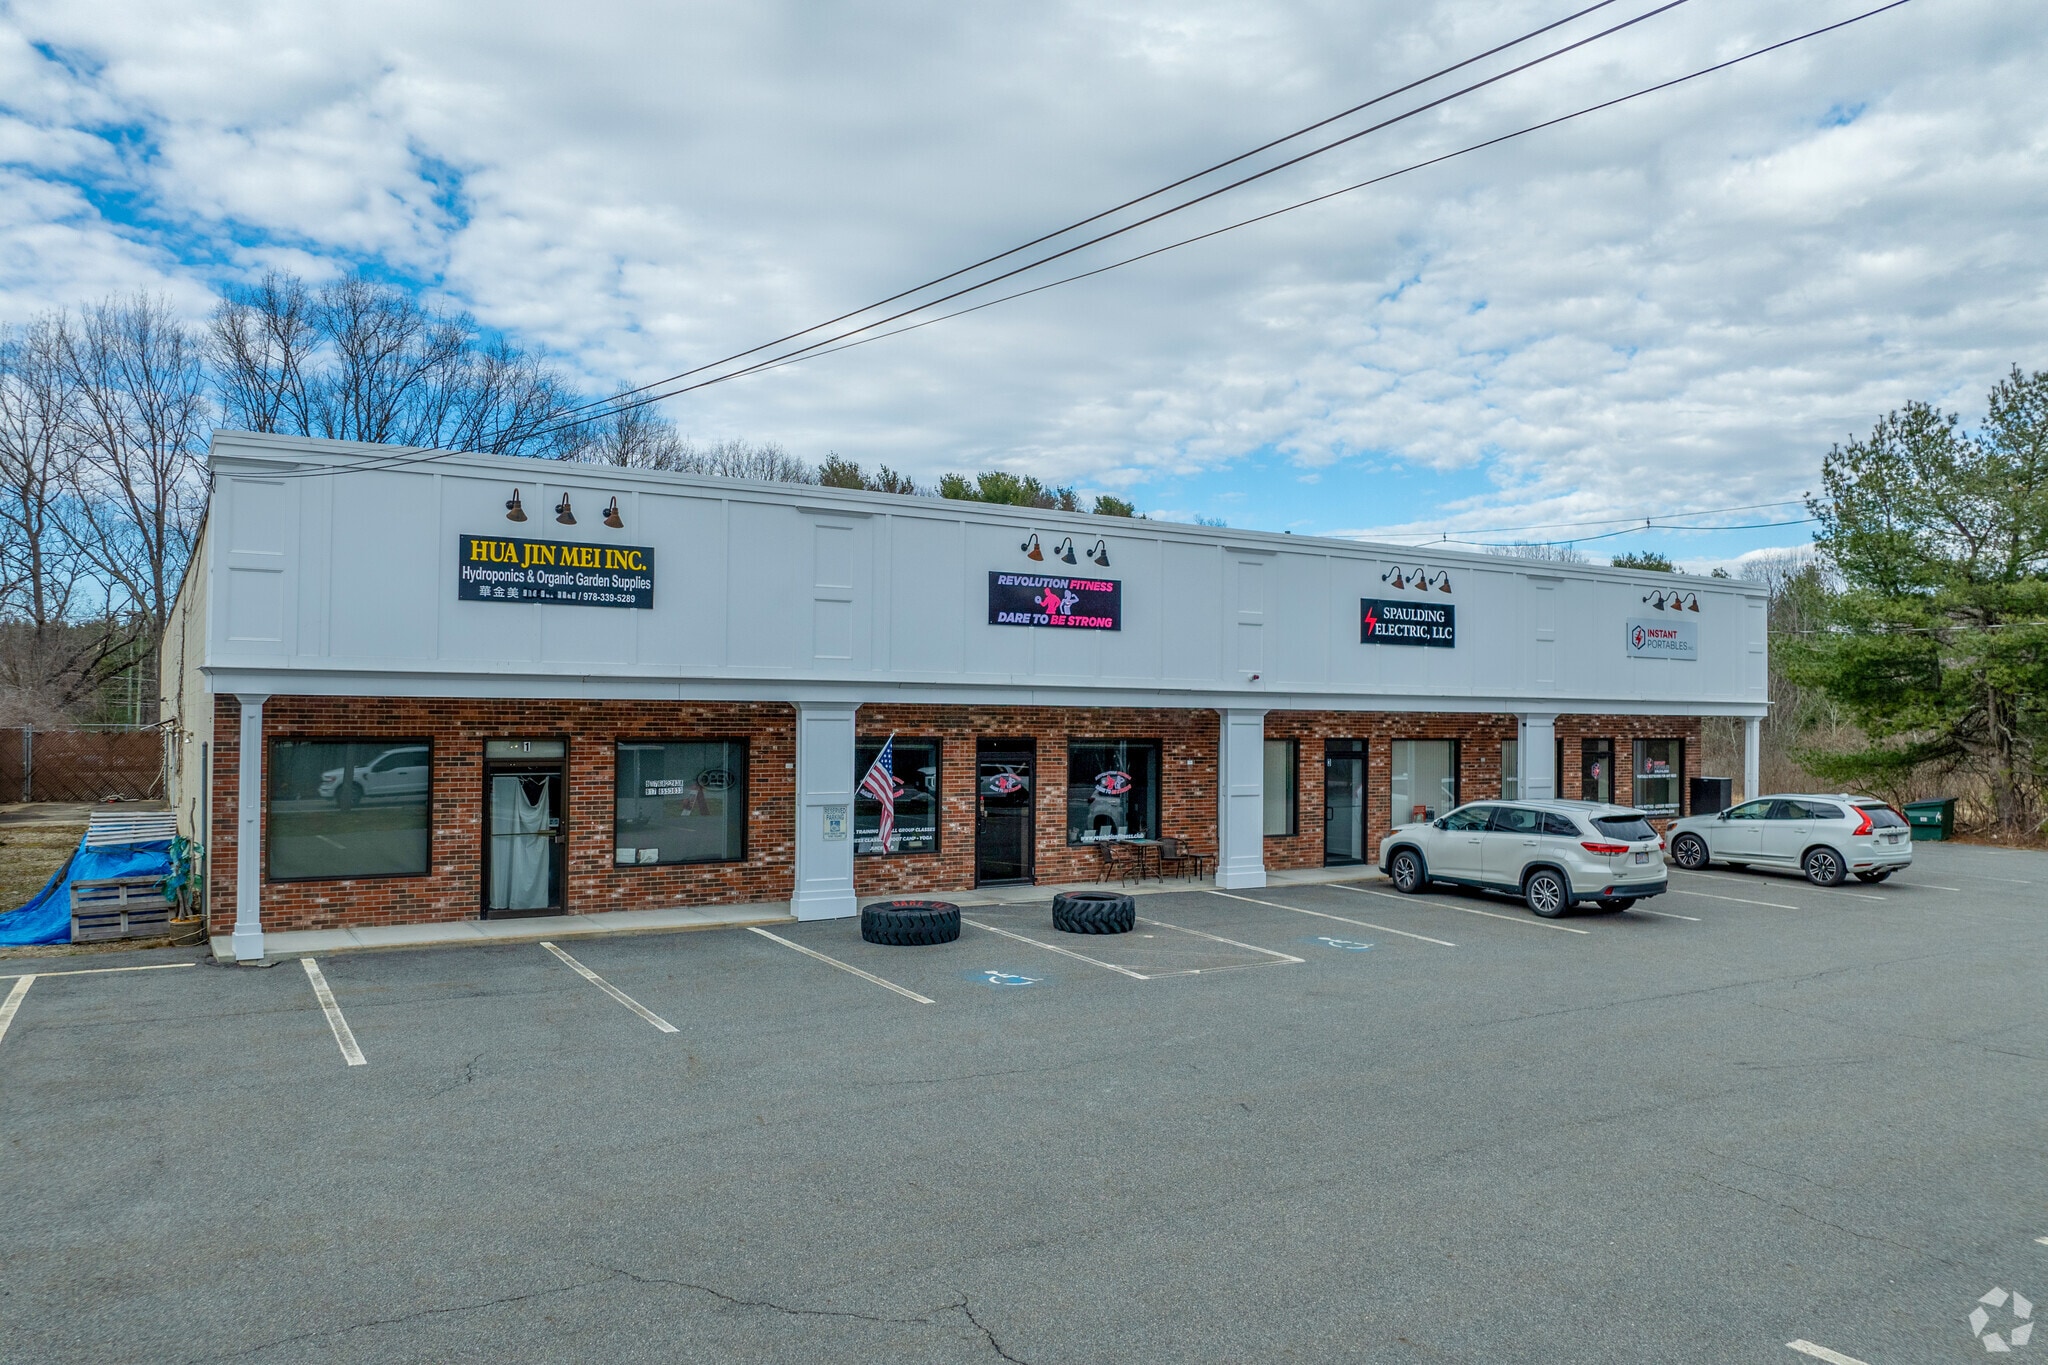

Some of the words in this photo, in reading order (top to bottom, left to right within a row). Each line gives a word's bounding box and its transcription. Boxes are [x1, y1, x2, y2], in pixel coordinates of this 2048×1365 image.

[470, 540, 519, 563] HUA
[521, 543, 556, 569] JIN
[559, 546, 601, 568] MEI
[604, 549, 647, 571] INC.
[462, 565, 525, 584] Hydroponics
[526, 569, 535, 583] &
[536, 570, 574, 588] Organic
[575, 573, 609, 588] Garden
[611, 574, 651, 592] Supplies
[997, 575, 1069, 589] REVOLUTION
[1069, 580, 1114, 592] FITNESS
[582, 591, 636, 604] 978-339-5289
[997, 611, 1032, 624] DARE
[1032, 614, 1049, 624] TO
[1050, 614, 1066, 625] BE
[1067, 616, 1113, 628] STRONG
[1383, 607, 1445, 623] SPAULDING
[1375, 623, 1430, 640] ELECTRIC,
[1432, 626, 1453, 639] LLC
[1647, 629, 1678, 639] INSTANT
[1647, 639, 1688, 651] PORTABLES
[525, 742, 529, 752] 1
